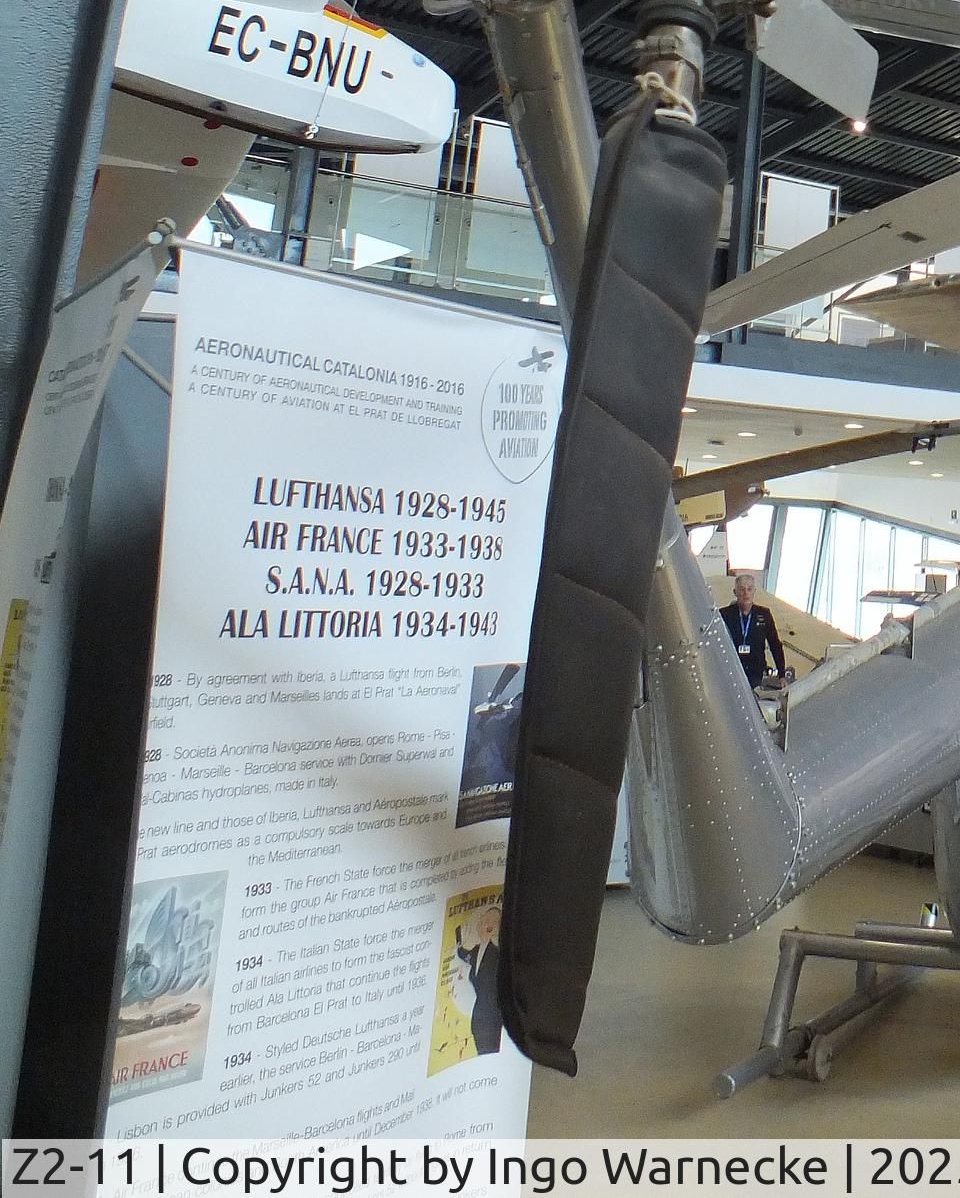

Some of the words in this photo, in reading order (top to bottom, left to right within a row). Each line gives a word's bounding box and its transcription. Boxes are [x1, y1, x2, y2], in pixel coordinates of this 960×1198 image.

[208, 5, 372, 94] EC-BNU
[195, 337, 320, 371] AERONAUTICAL
[323, 358, 397, 385] CATALONIA
[400, 373, 428, 390] 1916
[436, 379, 465, 395] 2016
[200, 383, 257, 401] CENTURY
[261, 392, 278, 403] OF
[281, 395, 329, 411] AVIATION
[333, 403, 345, 413] AT
[349, 405, 360, 416] EL
[364, 407, 388, 420] PRAT
[391, 411, 404, 423] DE
[407, 414, 462, 430] LLOBREGAT
[201, 365, 250, 382] CENTURY
[253, 373, 268, 385] OF
[270, 377, 341, 397] AERONAUTICAL
[343, 388, 404, 406] DEVELOPMENT
[405, 398, 424, 409] AND
[426, 401, 463, 416] TRAINING
[499, 382, 518, 404] 100
[520, 383, 544, 405] YEARS
[493, 409, 547, 431] PROMOTING
[499, 437, 539, 458] AVIATION
[253, 476, 385, 514] LUFTHANSA
[394, 489, 507, 523] 1928-1945
[243, 520, 288, 550] AIR
[296, 523, 384, 555] FRANCE
[393, 530, 504, 561] 1933-1938
[265, 565, 356, 595] S.A.N.A.
[366, 569, 484, 598] 1928-1933
[219, 609, 269, 639] ALA
[278, 609, 383, 639] LITTORIA
[392, 610, 499, 638] 1934-1943
[186, 672, 202, 688] By
[207, 673, 266, 688] agreement
[271, 671, 292, 683] with
[340, 669, 384, 682] Lufthansa
[388, 668, 409, 682] flight
[414, 667, 433, 678] from
[197, 693, 241, 706] Geneva
[246, 692, 266, 704] and
[323, 688, 348, 702] lands
[375, 686, 394, 698] Prat
[220, 743, 268, 757] Anonima
[272, 739, 332, 754] Navigazione
[181, 766, 231, 780] Marseille
[245, 762, 297, 776] Barcelona
[301, 757, 334, 771] service
[338, 754, 357, 767] with
[201, 783, 271, 802] hydroplanes,
[275, 779, 304, 793] made
[147, 825, 171, 838] new
[173, 820, 194, 835] line
[196, 817, 219, 832] and
[222, 815, 254, 829] those
[256, 812, 267, 825] of
[303, 804, 351, 820] Lufthansa
[353, 800, 372, 813] and
[162, 839, 233, 857] aerodromes
[237, 836, 250, 847] as
[265, 828, 326, 844] compulsory
[328, 822, 354, 836] scale
[357, 817, 396, 832] towards
[248, 854, 265, 867] the
[245, 882, 272, 898] 1933
[285, 878, 303, 891] The
[306, 871, 341, 888] French
[343, 867, 370, 882] State
[372, 863, 397, 877] force
[400, 861, 414, 873] the
[241, 905, 266, 919] form
[270, 901, 288, 914] the
[291, 896, 321, 914] group
[324, 891, 338, 904] Air
[341, 887, 376, 901] France
[379, 883, 397, 895] that
[238, 923, 261, 940] and
[262, 920, 296, 935] routes
[297, 914, 309, 929] of
[310, 912, 327, 927] the
[328, 900, 385, 923] bankrupted
[235, 955, 263, 972] 1934
[278, 949, 297, 963] The
[300, 943, 330, 959] Italian
[333, 937, 360, 952] State
[363, 932, 388, 946] force
[391, 928, 406, 940] the
[232, 979, 243, 994] of
[245, 976, 258, 991] all
[260, 970, 291, 987] Italian
[293, 962, 329, 980] airlines
[344, 954, 367, 969] form
[369, 949, 385, 962] the
[230, 995, 264, 1015] trolled
[266, 993, 284, 1006] Ala
[287, 983, 323, 1002] Littoria
[326, 979, 345, 992] that
[348, 968, 391, 988] continue
[227, 1020, 253, 1037] from
[256, 1006, 310, 1030] Barcelona
[327, 996, 348, 1011] Prat
[365, 988, 384, 1004] Italy
[224, 1050, 252, 1069] 1934
[265, 1039, 299, 1059] Styled
[302, 1027, 352, 1049] Deutsche
[355, 1013, 400, 1035] Lufthansa
[132, 1050, 189, 1077] FRANCE
[219, 1073, 256, 1092] earlier,
[259, 1066, 277, 1081] the
[279, 1056, 317, 1076] service
[319, 1046, 348, 1065] Berlin
[357, 1032, 402, 1054] Barcelona
[177, 1100, 230, 1129] provided
[233, 1091, 258, 1109] with
[260, 1080, 304, 1102] Junkers
[325, 1065, 346, 1082] and
[468, 1076, 498, 1090] come
[470, 1121, 494, 1135] from
